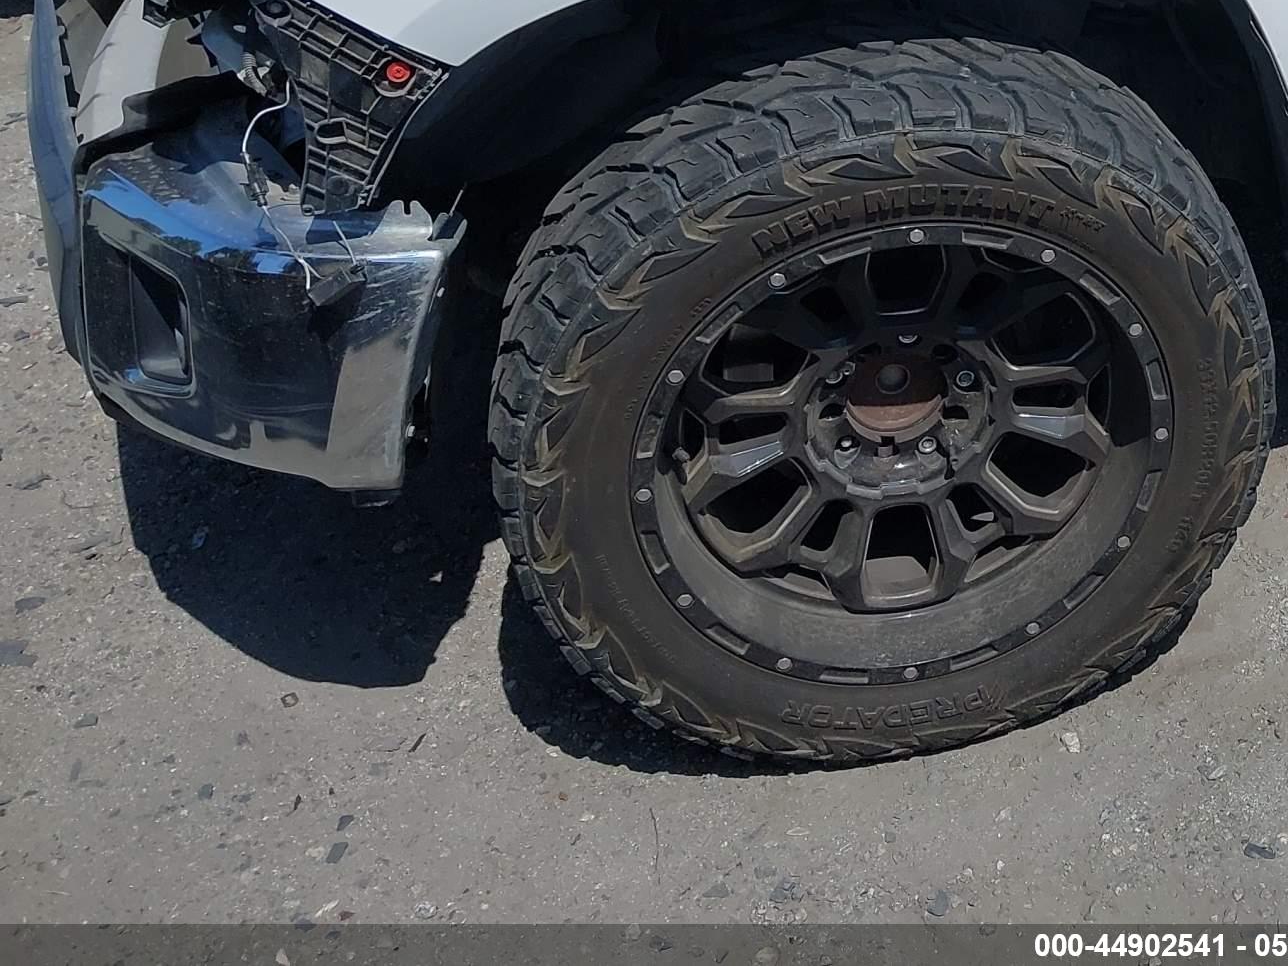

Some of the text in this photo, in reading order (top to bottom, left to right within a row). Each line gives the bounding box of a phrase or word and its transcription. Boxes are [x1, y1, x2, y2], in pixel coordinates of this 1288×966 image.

[751, 195, 852, 258] NEW
[864, 184, 1056, 229] MUTANT
[780, 684, 993, 731] PREDATOR
